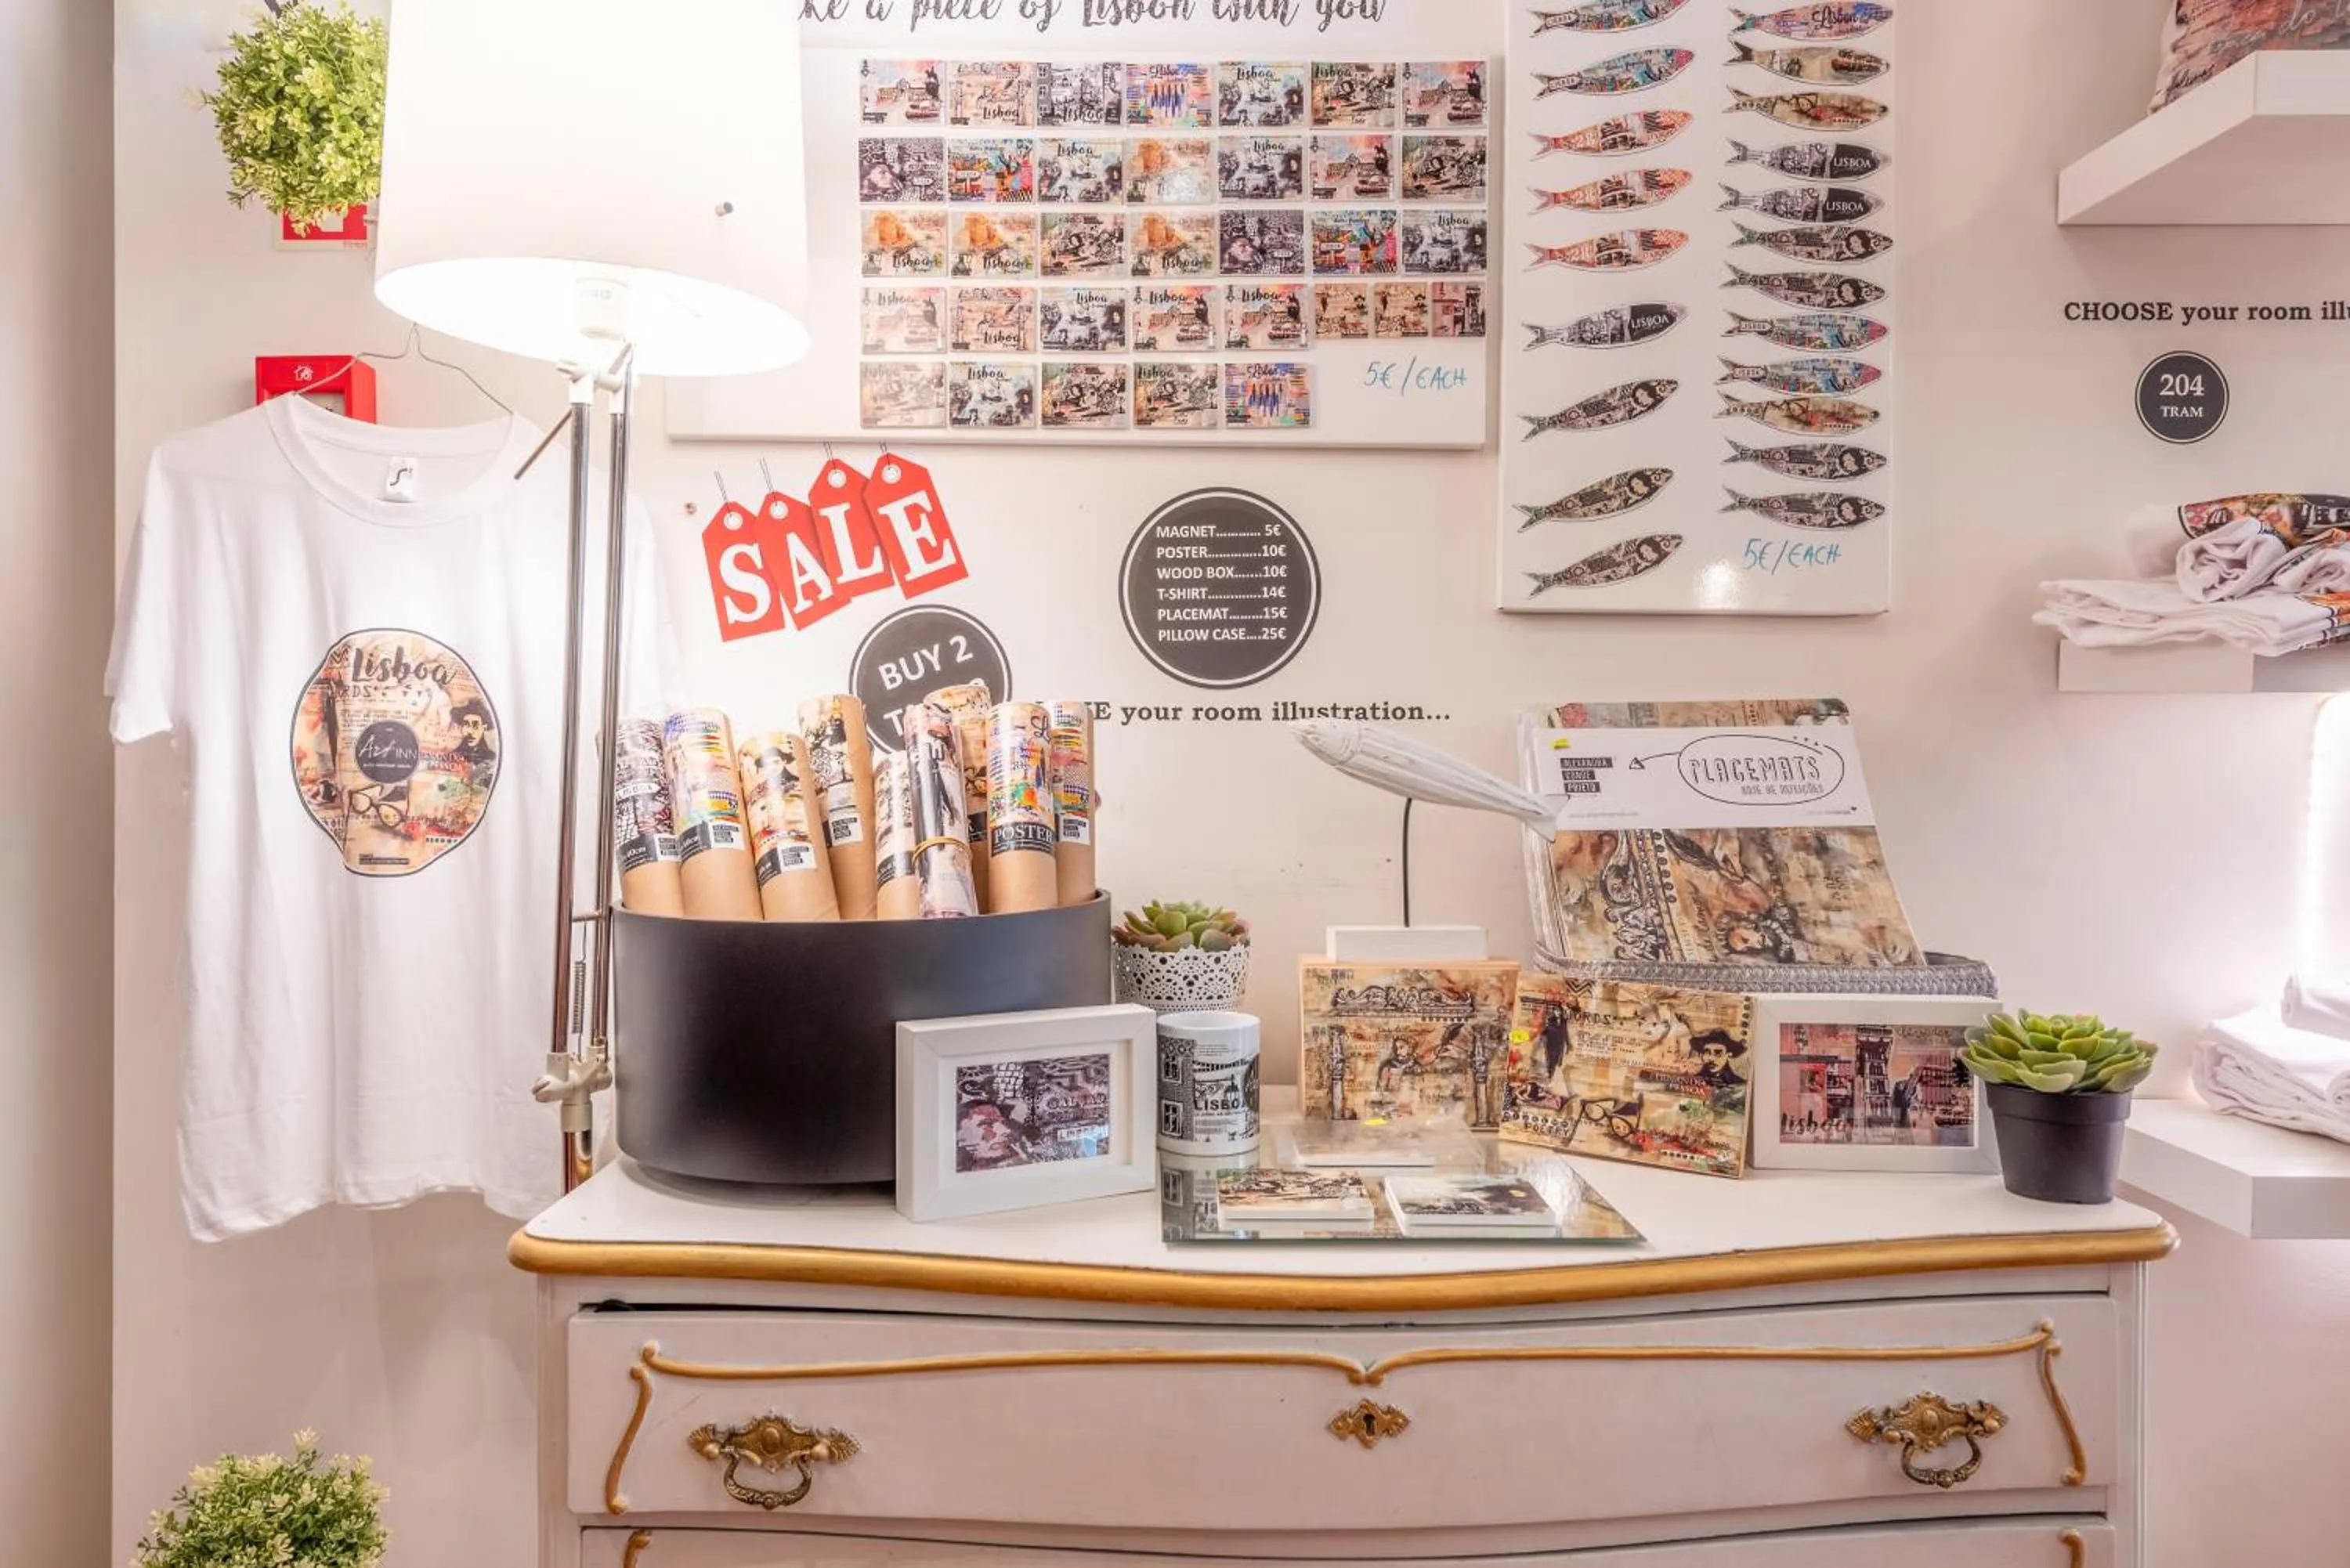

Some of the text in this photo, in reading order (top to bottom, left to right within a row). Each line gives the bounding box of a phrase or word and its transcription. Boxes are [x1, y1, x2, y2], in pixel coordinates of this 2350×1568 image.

[1314, 0, 1387, 32] you
[1833, 157, 1871, 168] LISBOA
[1825, 201, 1864, 211] LISBOA
[1630, 312, 1669, 330] LISBOA
[2064, 302, 2173, 321] CHOOSE
[2181, 305, 2239, 326] your
[2247, 305, 2312, 320] room
[2158, 374, 2205, 397] 204
[2160, 406, 2204, 418] TRAM
[718, 490, 957, 625] SALE
[1156, 566, 1203, 580] WOOD
[1158, 628, 1209, 642] PILLOW
[351, 645, 457, 685] Lisboa
[877, 635, 974, 690] BUY 2
[1120, 705, 1182, 726] your
[1191, 705, 1262, 721] room
[1688, 756, 1820, 784] PLACEMATS
[994, 824, 1053, 844] POSTER
